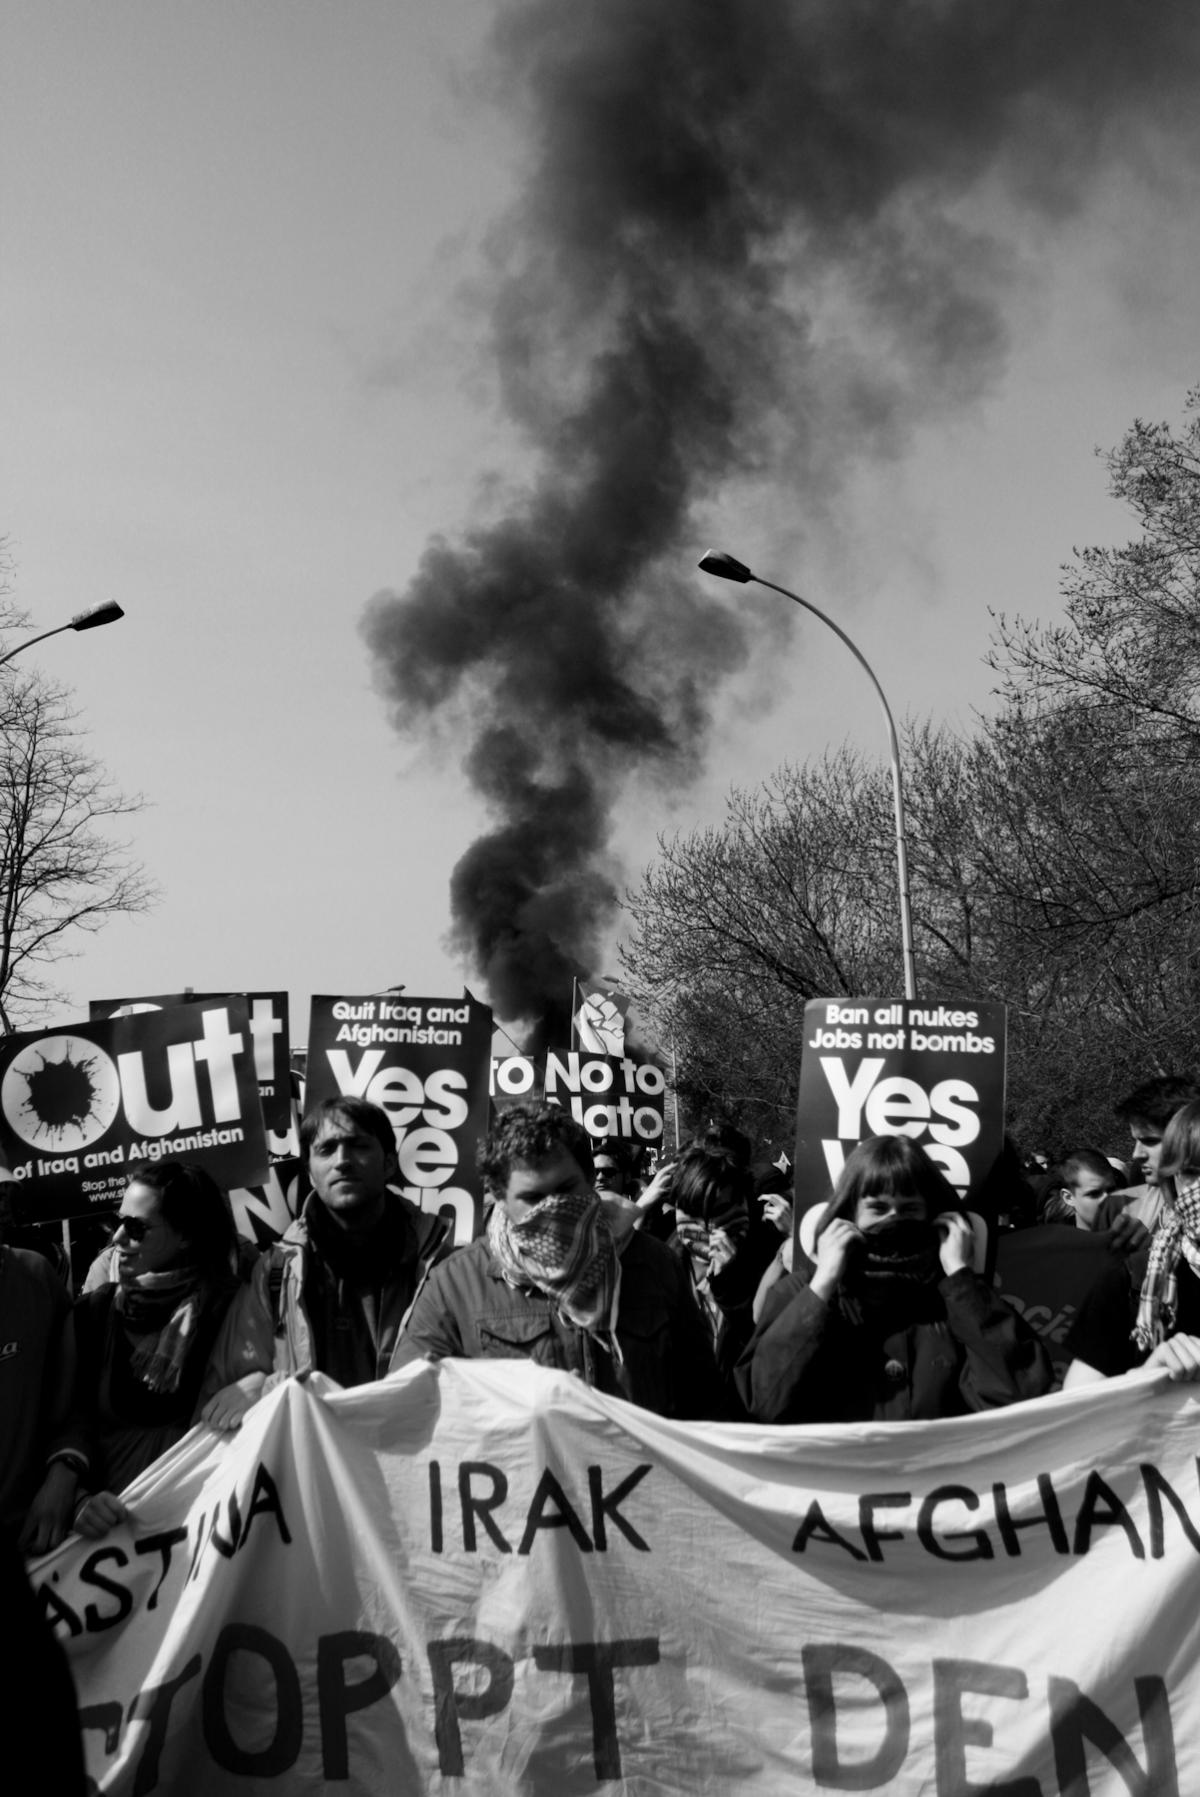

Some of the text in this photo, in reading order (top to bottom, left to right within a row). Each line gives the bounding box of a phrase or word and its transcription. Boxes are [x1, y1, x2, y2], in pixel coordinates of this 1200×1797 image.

[332, 1002, 470, 1025] Quit Iraq and
[336, 1024, 462, 1047] Afghanistan
[825, 1005, 978, 1028] Ban all nukes
[809, 1029, 995, 1054] Jobs not bombs
[2, 1008, 244, 1153] Out
[326, 1050, 468, 1130] Yes
[545, 1052, 665, 1095] No to
[819, 1057, 980, 1147] Yes
[13, 1161, 32, 1180] of
[38, 1156, 79, 1176] Iraq
[84, 1145, 124, 1168] and
[128, 1128, 244, 1161] Afghanistan
[396, 1127, 458, 1188] e
[82, 1180, 107, 1192] Stop
[108, 1176, 126, 1187] the
[428, 1460, 653, 1555] IRAK
[792, 1457, 1200, 1561] AFGHAN
[801, 1643, 1179, 1797] DEN
